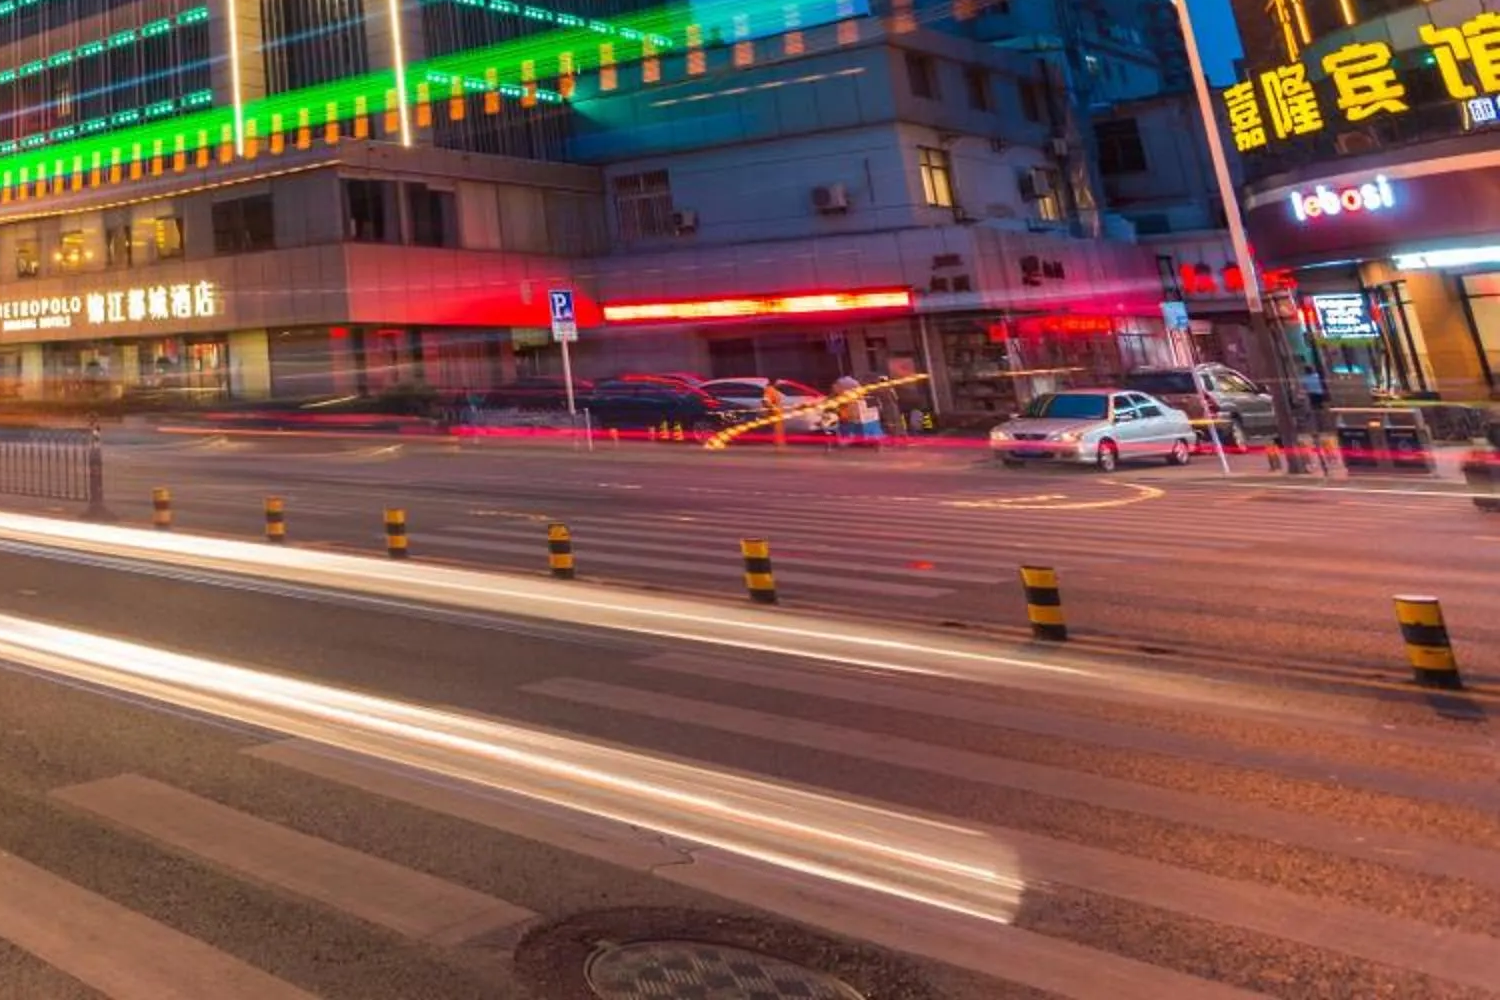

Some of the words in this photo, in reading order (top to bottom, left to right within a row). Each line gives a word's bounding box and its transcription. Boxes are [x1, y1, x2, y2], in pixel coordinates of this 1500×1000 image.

[1223, 11, 1500, 151] 嘉隆宾馆
[86, 280, 215, 325] 锦江都城酒店
[552, 293, 567, 319] P
